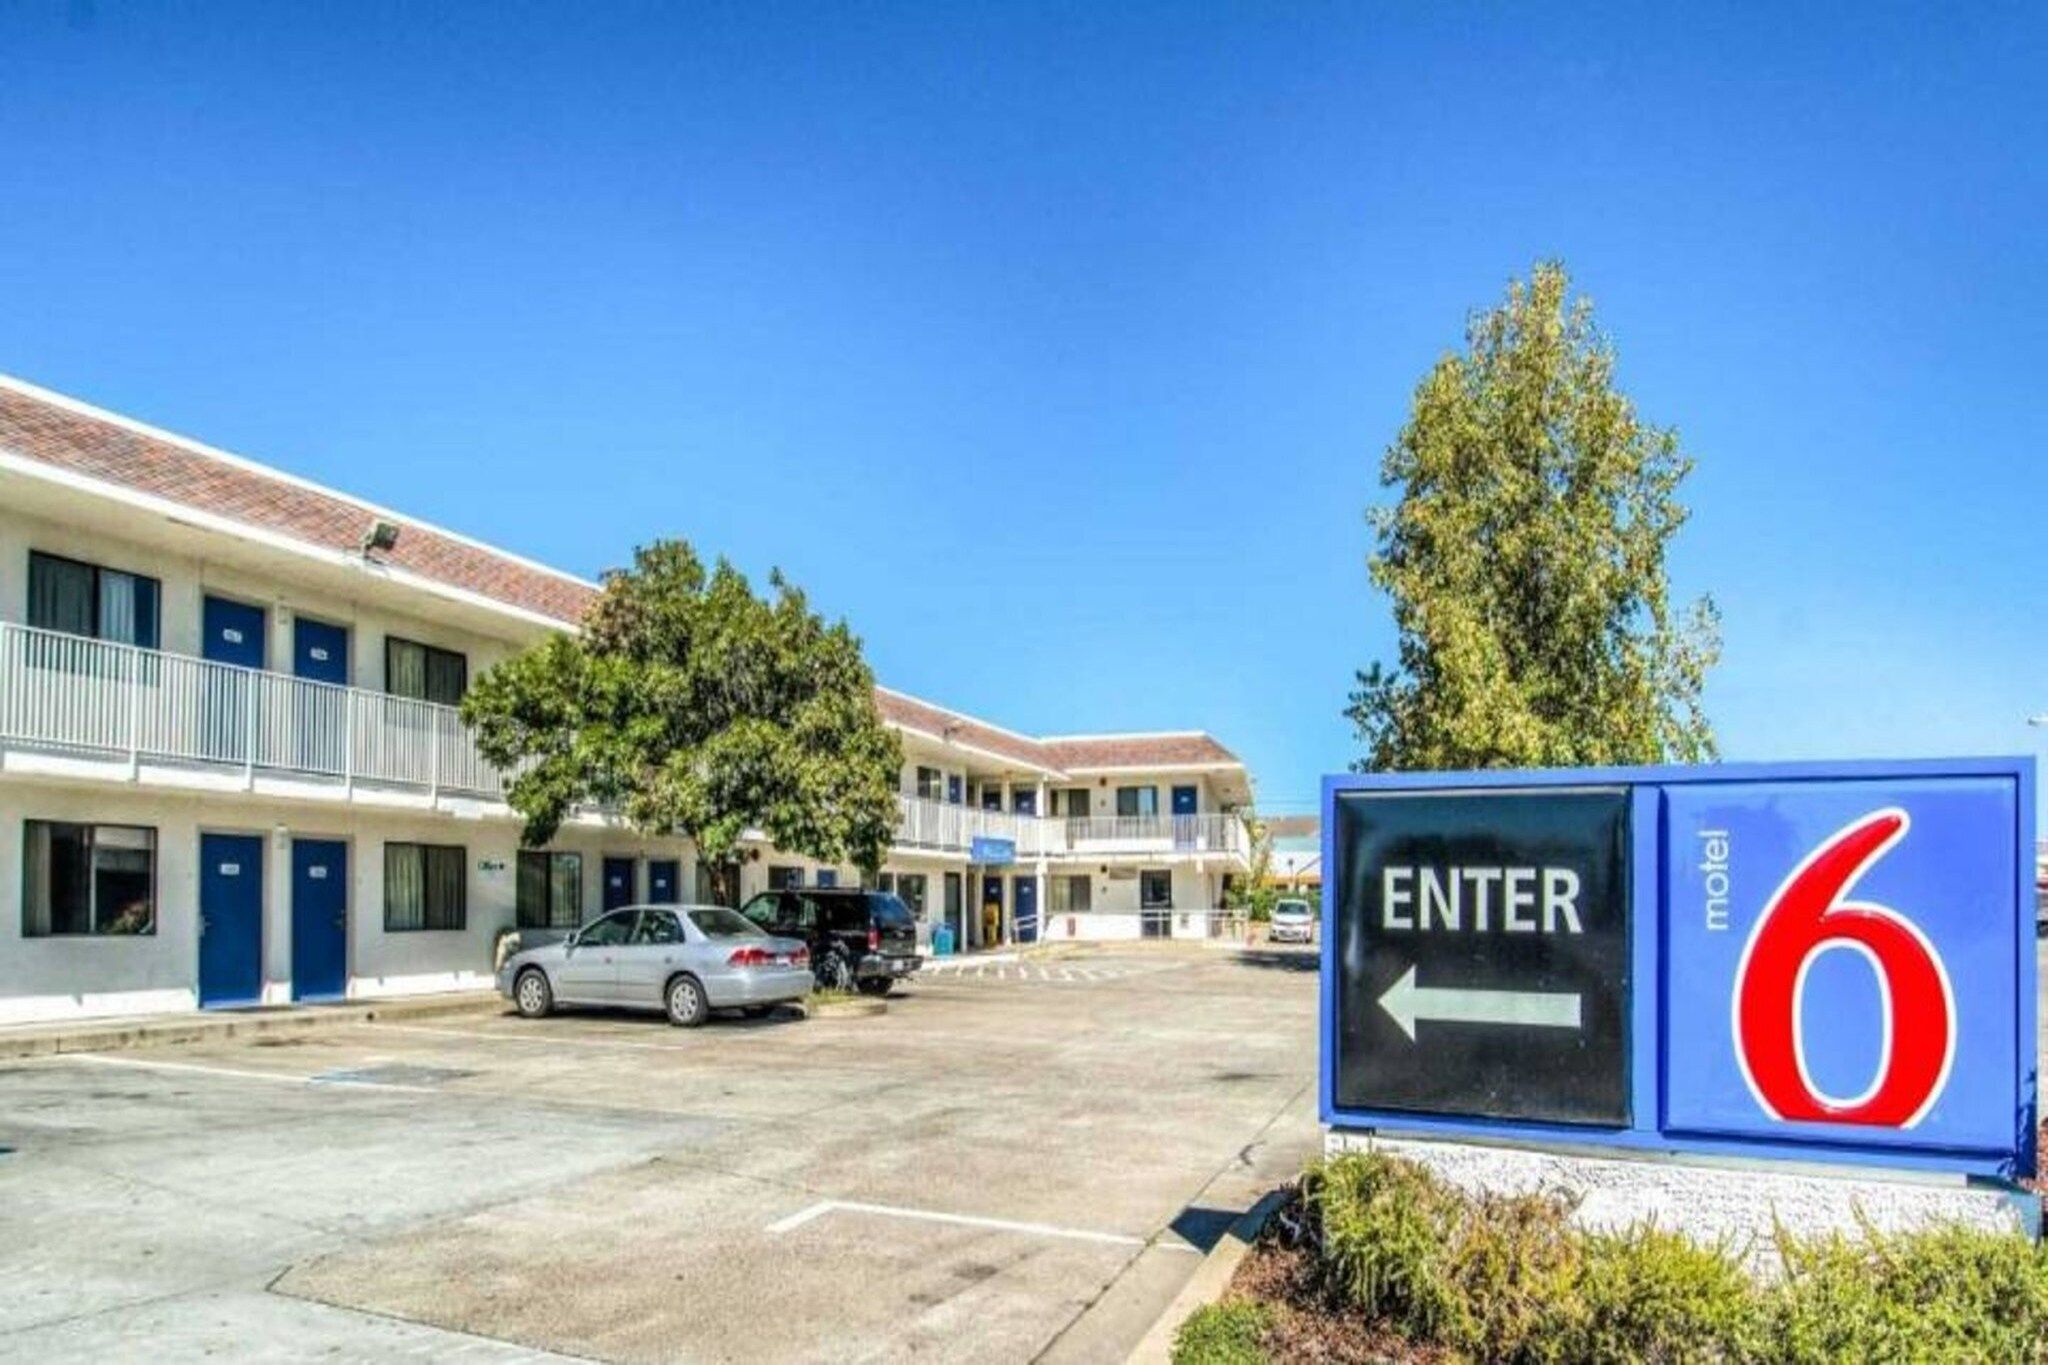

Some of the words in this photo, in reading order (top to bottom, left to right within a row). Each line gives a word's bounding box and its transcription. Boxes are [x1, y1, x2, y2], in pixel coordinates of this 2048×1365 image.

[1383, 867, 1583, 932] ENTER
[1698, 830, 1729, 930] motel
[1731, 806, 1957, 1129] 6
